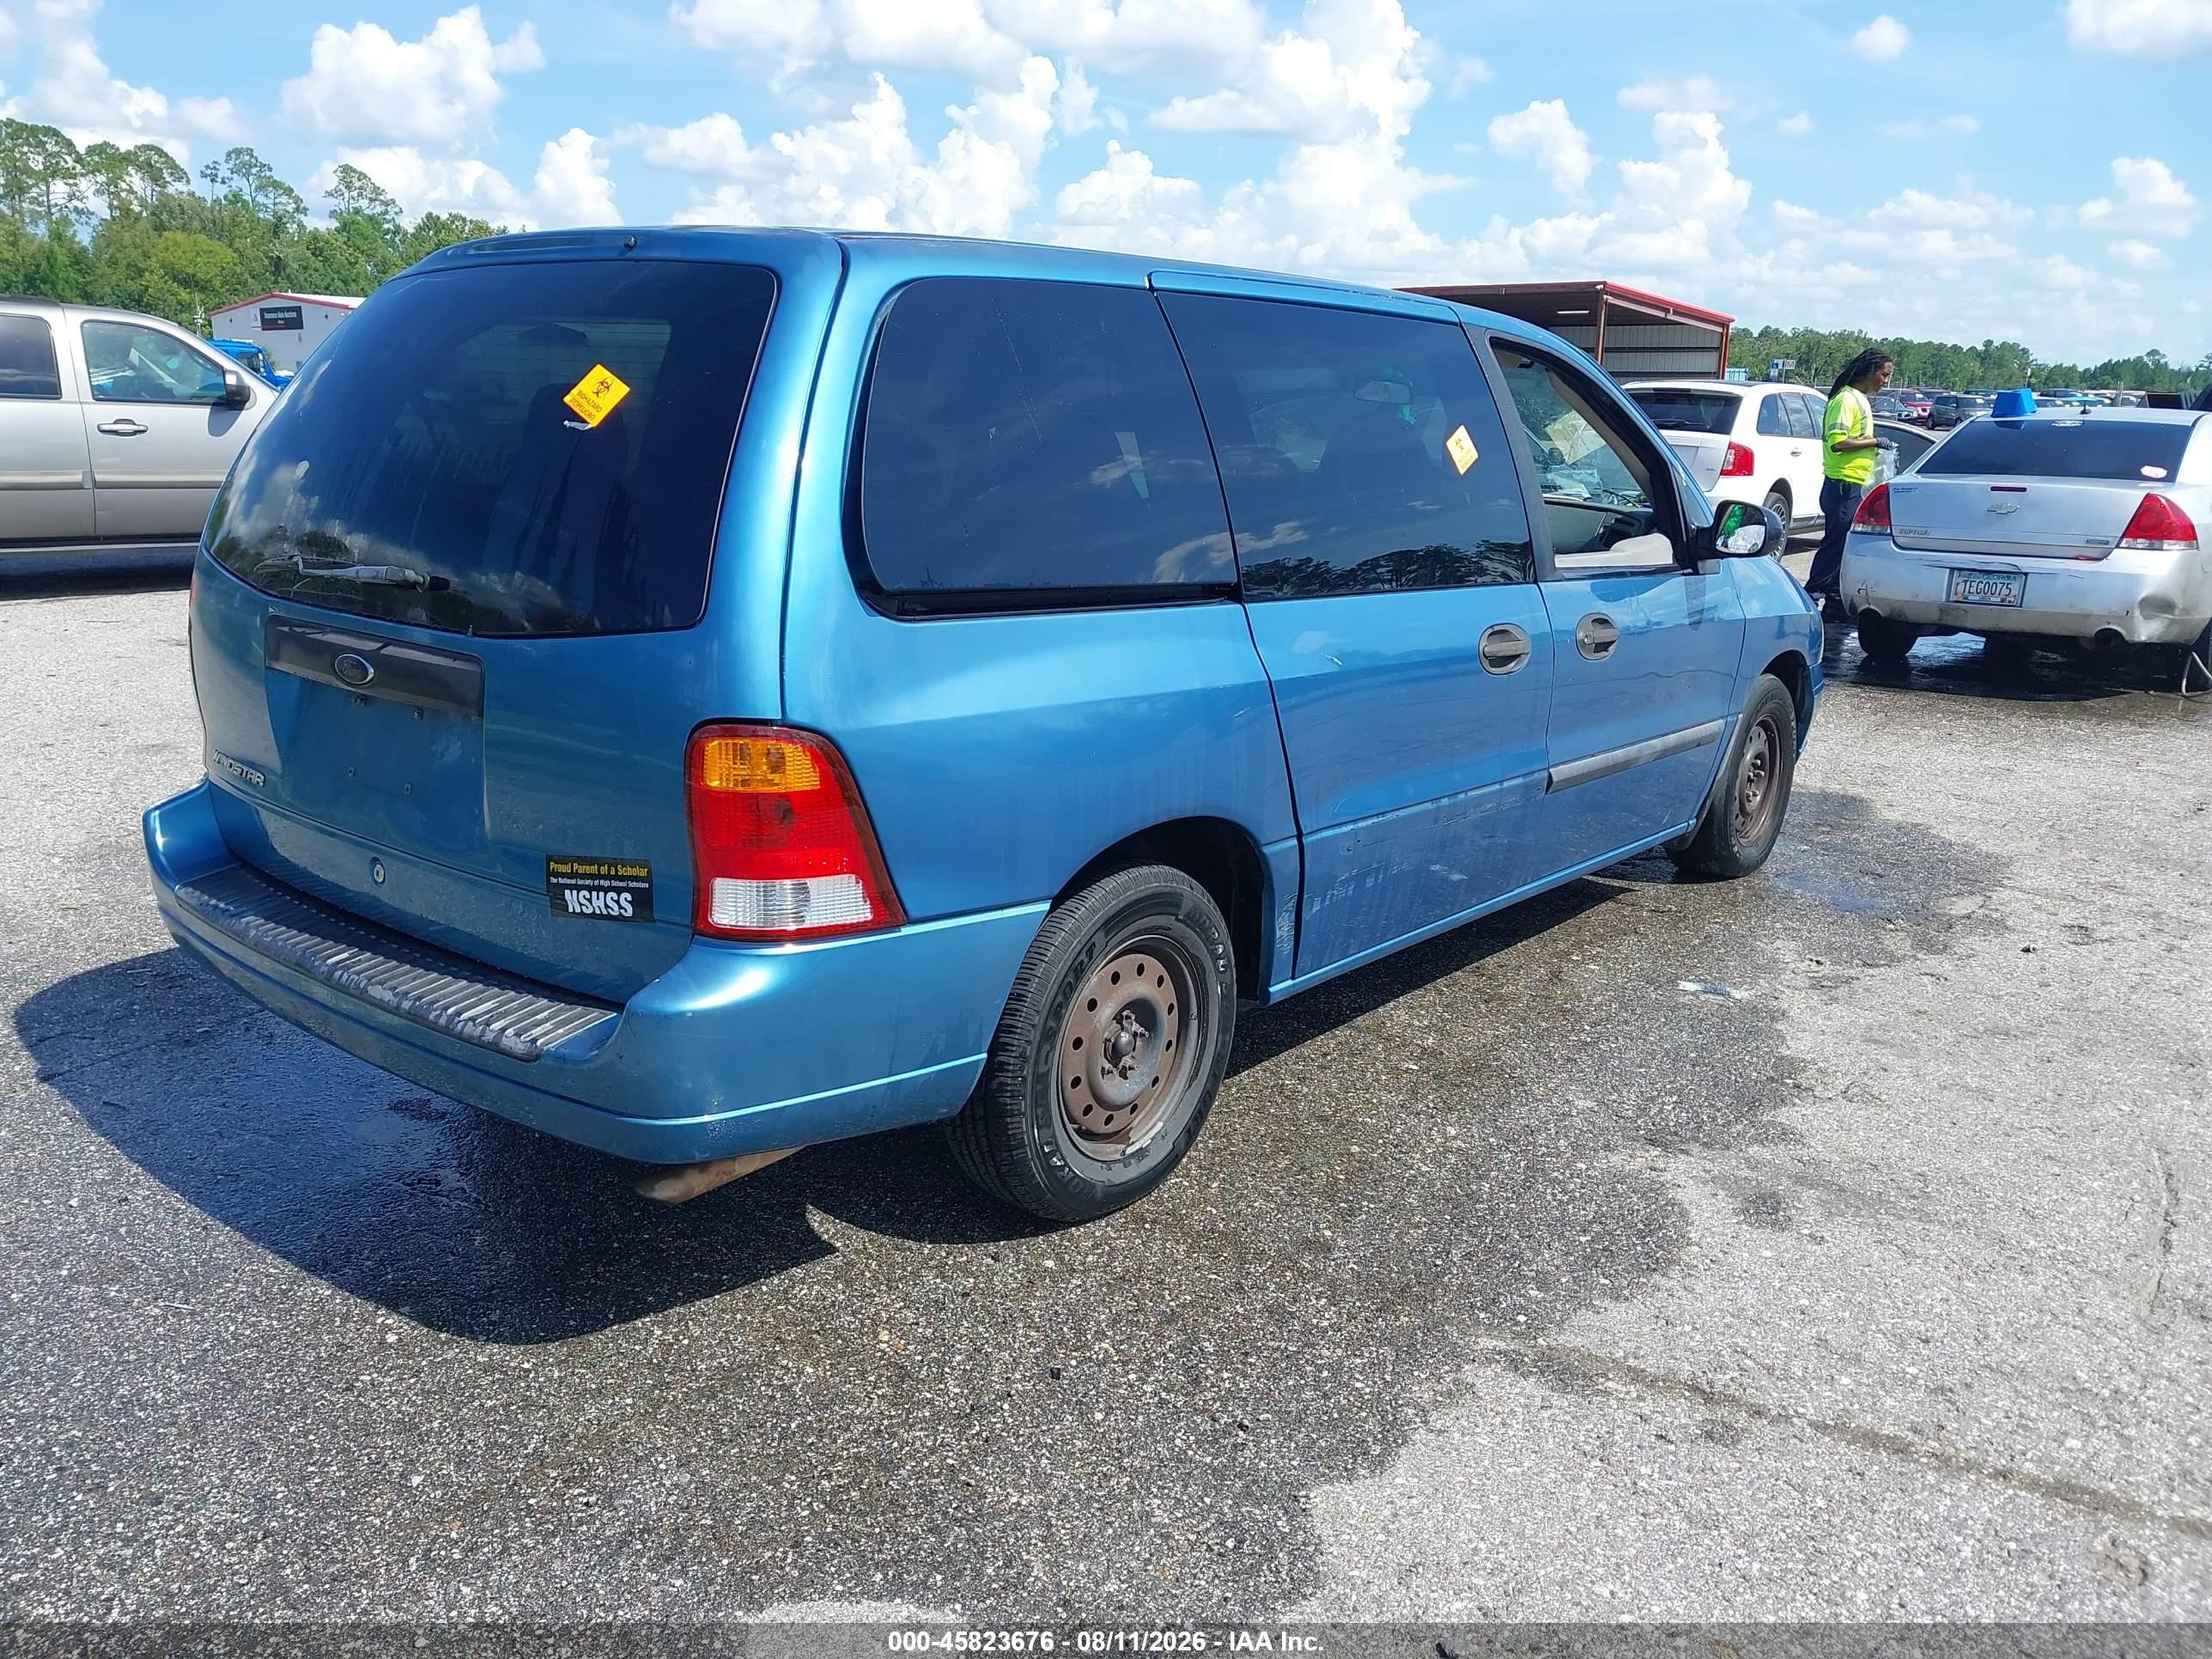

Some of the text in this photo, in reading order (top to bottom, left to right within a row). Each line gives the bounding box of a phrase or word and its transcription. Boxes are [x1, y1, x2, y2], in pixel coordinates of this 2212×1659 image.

[576, 390, 603, 413] BIOHAZARD
[1962, 579, 2012, 597] TEG0075
[550, 861, 648, 877] Proud Parent of a Scholar
[577, 878, 593, 886] Society
[564, 890, 633, 917] NSHSS
